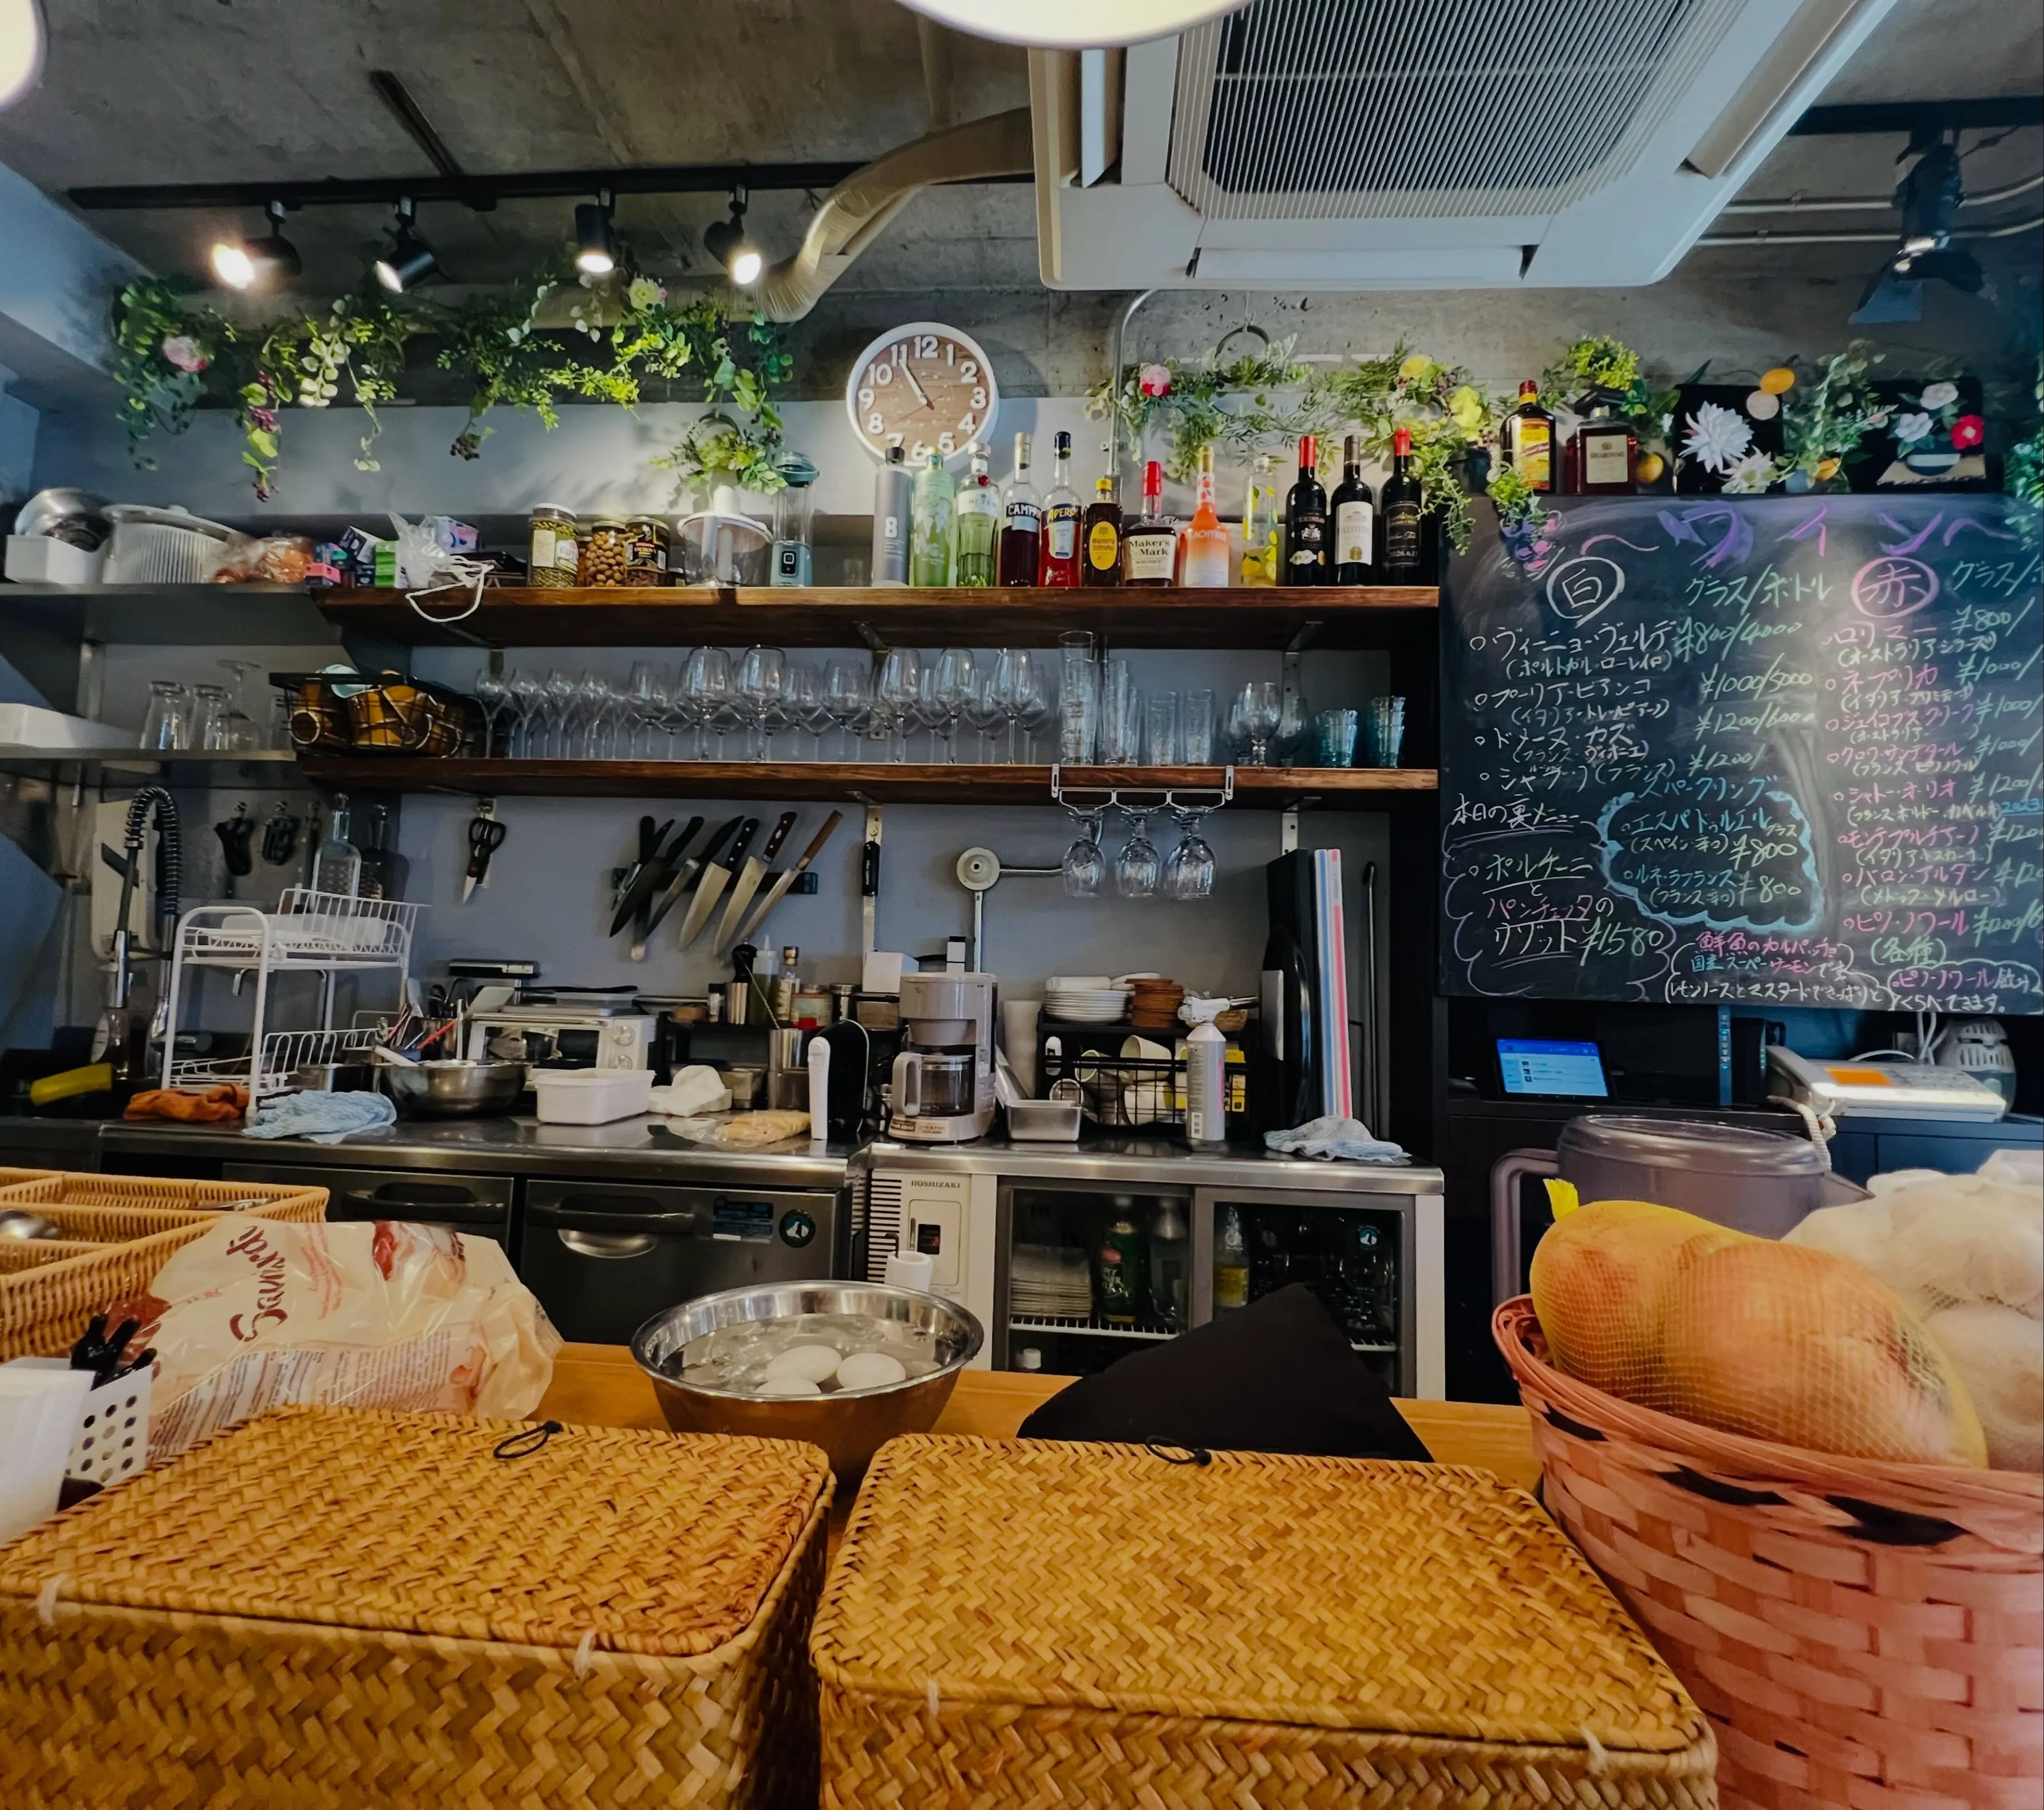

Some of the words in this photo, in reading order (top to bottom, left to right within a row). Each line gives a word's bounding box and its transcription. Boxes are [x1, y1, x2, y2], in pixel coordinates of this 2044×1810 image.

[891, 344, 908, 366] 11
[914, 335, 939, 359] 12
[946, 343, 955, 366] 1
[868, 363, 893, 386] 10
[960, 361, 978, 383] 2
[858, 388, 876, 410] 9
[970, 386, 987, 409] 3
[868, 413, 884, 435] 8
[958, 412, 976, 435] 4
[911, 440, 928, 461] 6
[939, 431, 955, 455] 5
[885, 516, 898, 538] 8
[1130, 539, 1170, 548] Maker's
[1139, 548, 1168, 556] Mark
[1860, 563, 1928, 608] 赤
[1452, 793, 1580, 831] 本日の裏メニュー
[1529, 883, 1544, 897] と
[1576, 916, 1664, 967] ¥1580
[911, 1181, 960, 1189] HOSHIZAKI
